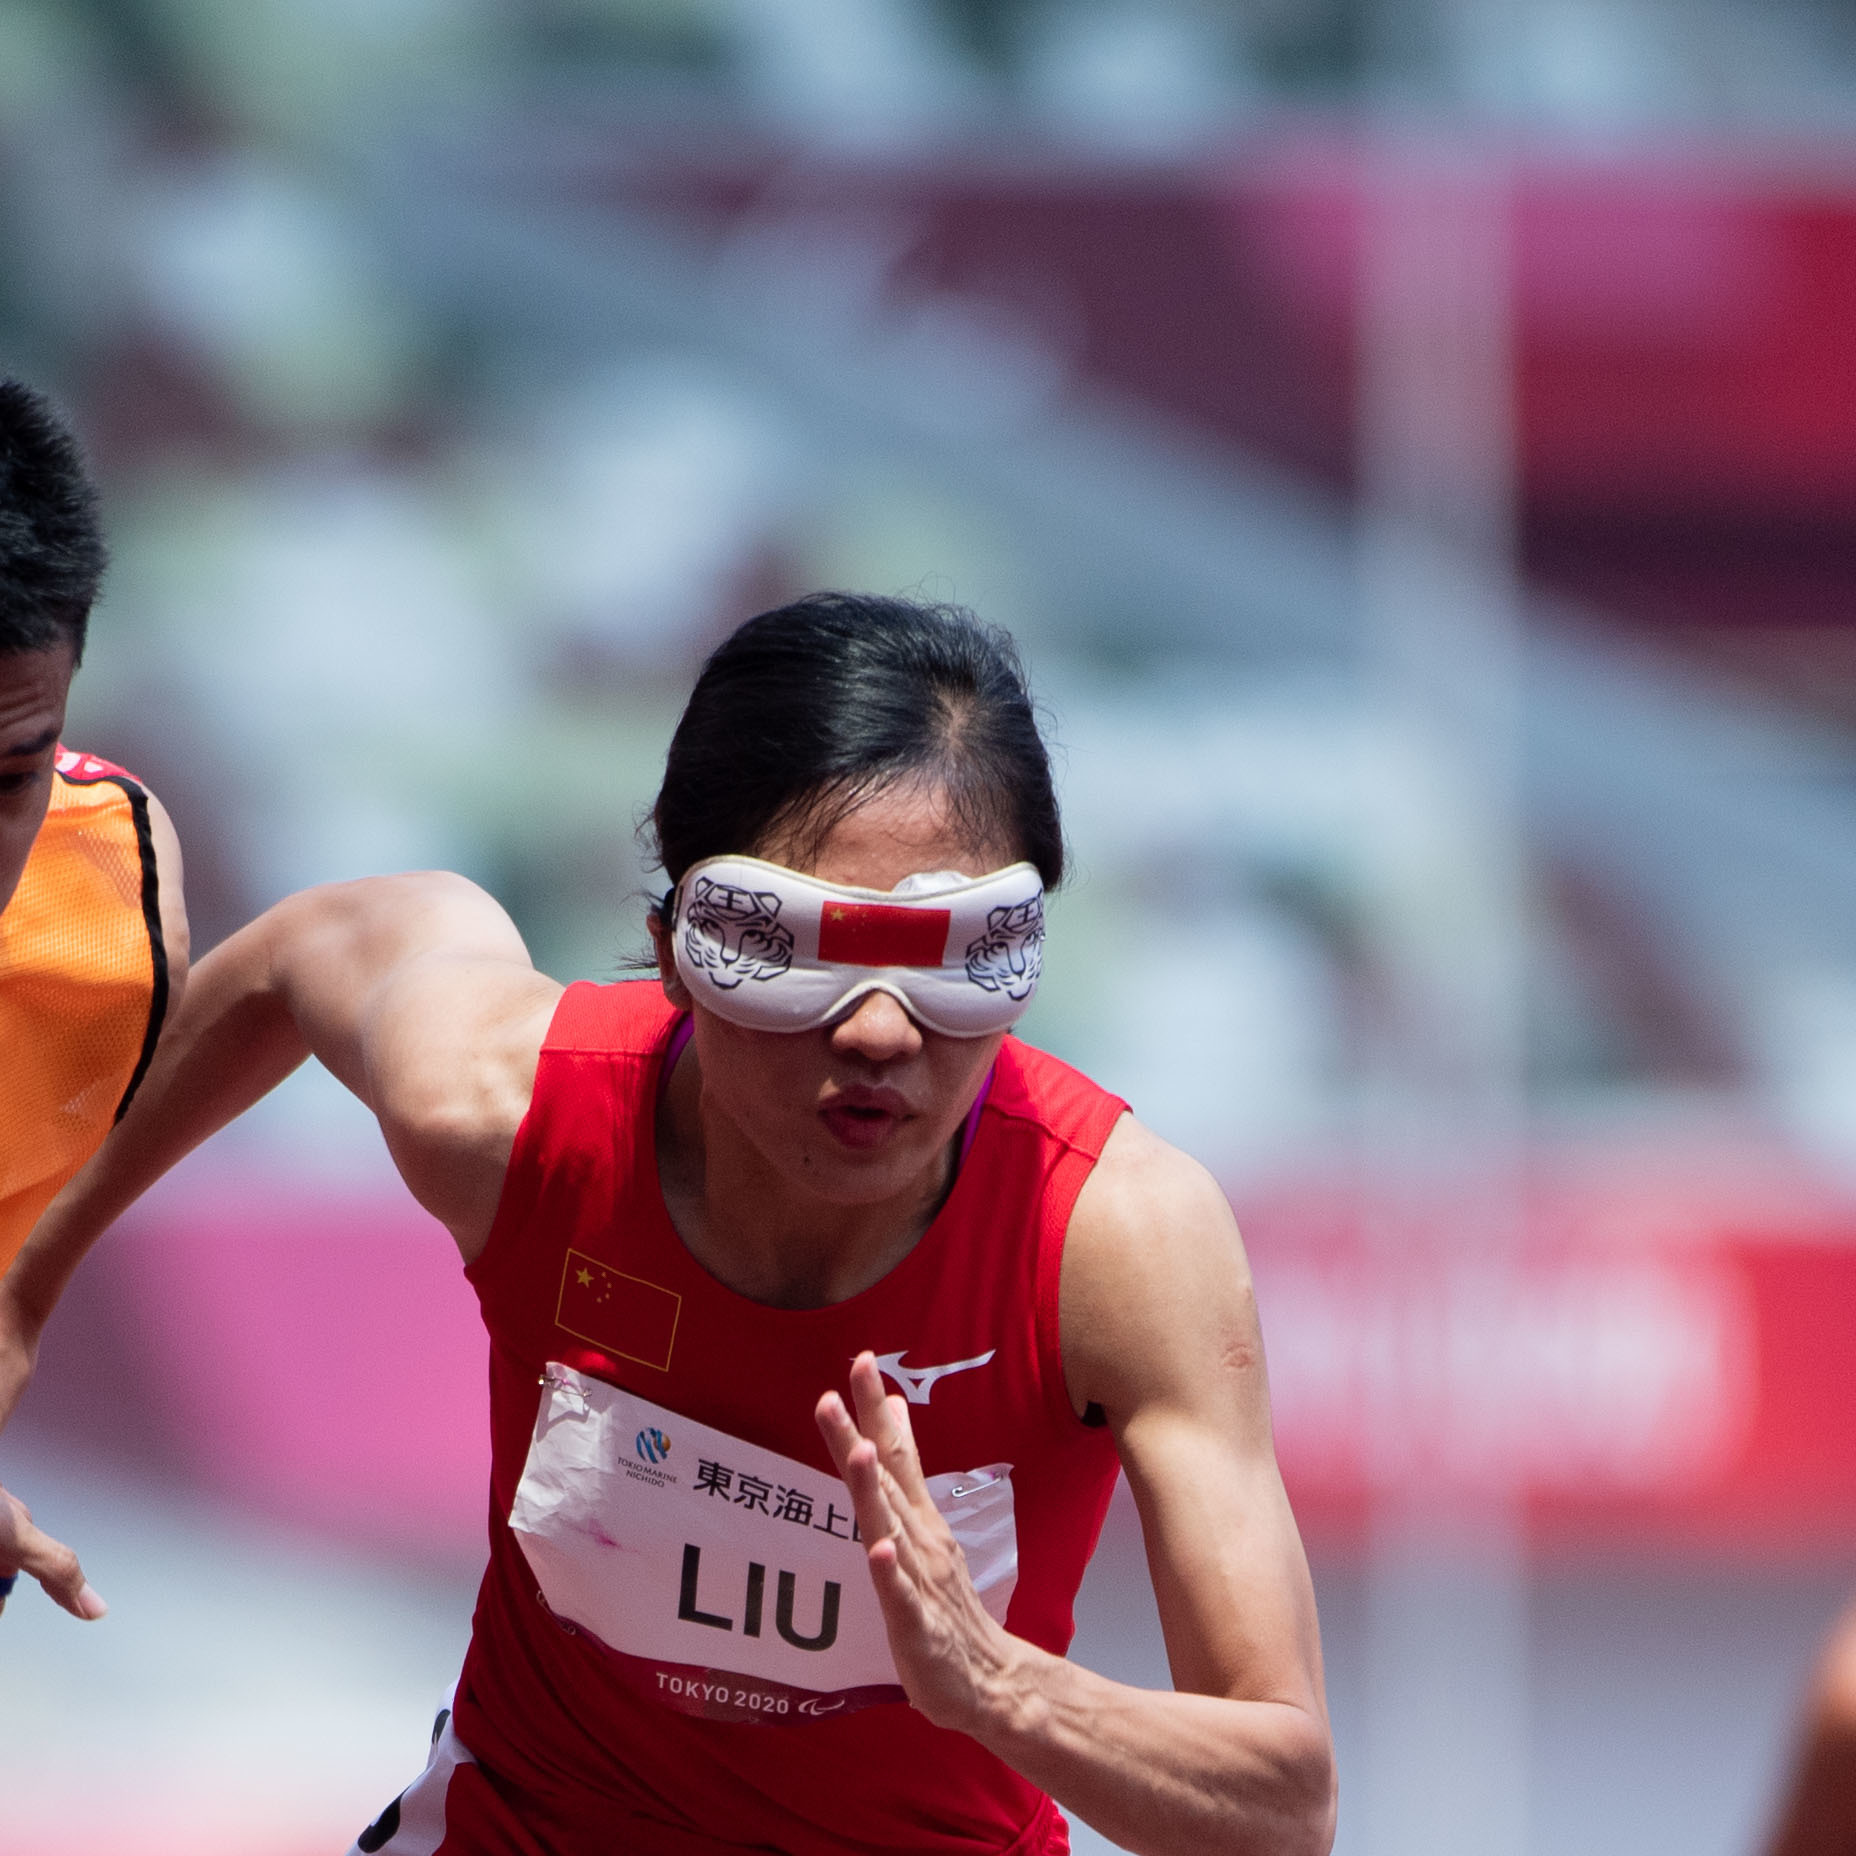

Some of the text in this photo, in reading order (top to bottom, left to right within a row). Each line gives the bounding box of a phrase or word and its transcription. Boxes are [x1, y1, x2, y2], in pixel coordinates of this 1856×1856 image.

[617, 1456, 678, 1484] TOKIO MARINE
[626, 1469, 665, 1489] NICHIDO
[678, 1543, 841, 1652] LIU
[656, 1671, 789, 1714] TOKYO 2020
